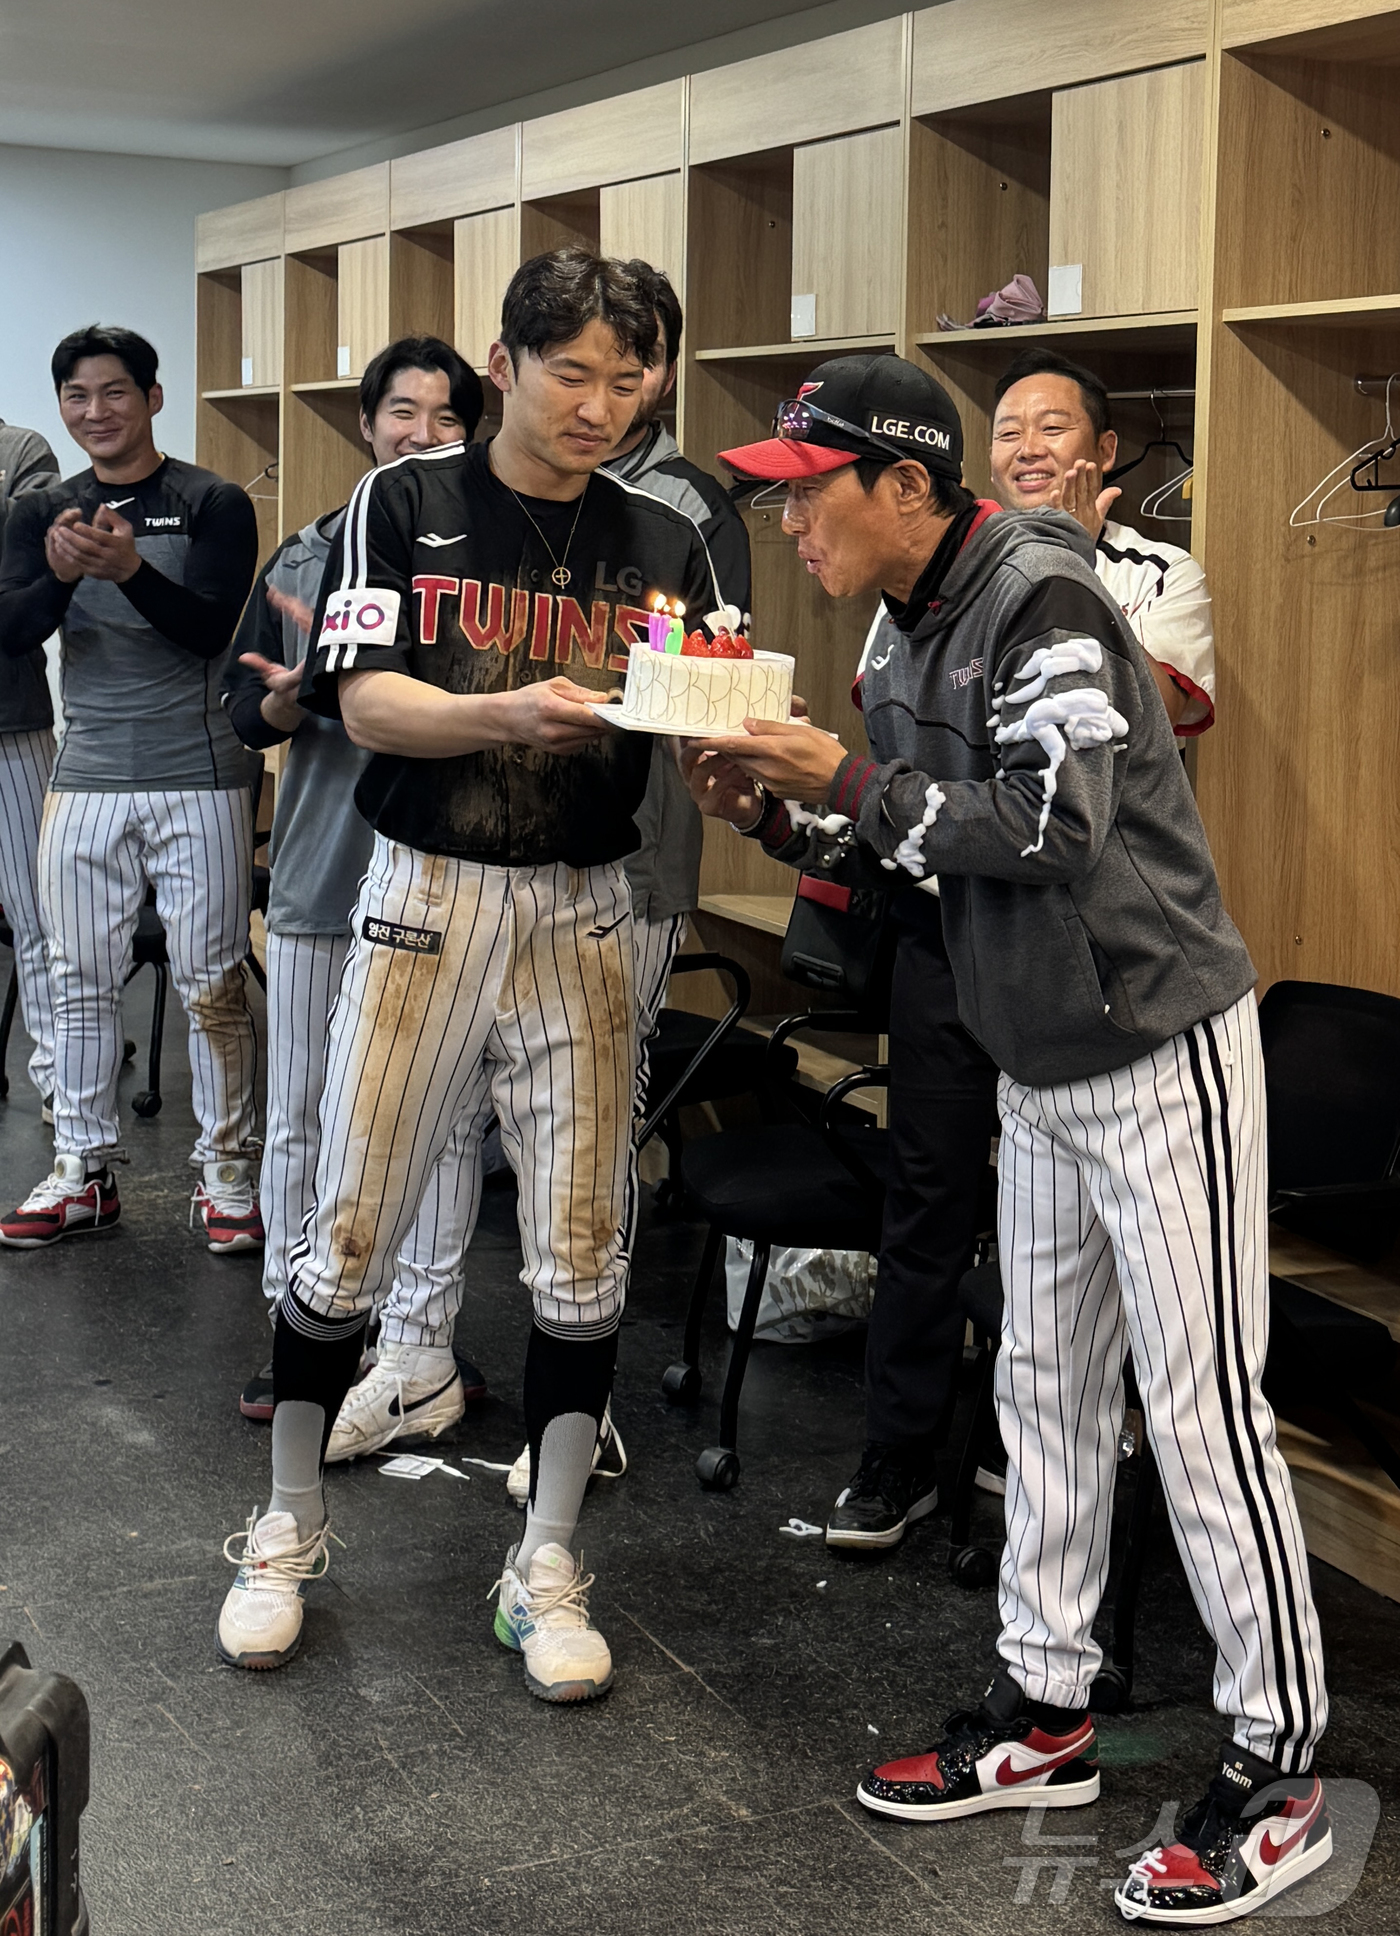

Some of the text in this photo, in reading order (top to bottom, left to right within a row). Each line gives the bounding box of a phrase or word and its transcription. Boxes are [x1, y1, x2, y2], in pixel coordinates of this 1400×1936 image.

[870, 415, 951, 451] LGE.COM
[144, 516, 181, 527] TWINS
[594, 560, 644, 597] LG
[412, 574, 653, 673] TWINS
[368, 922, 434, 949] 영진 구론산
[1221, 1761, 1253, 1789] Youm
